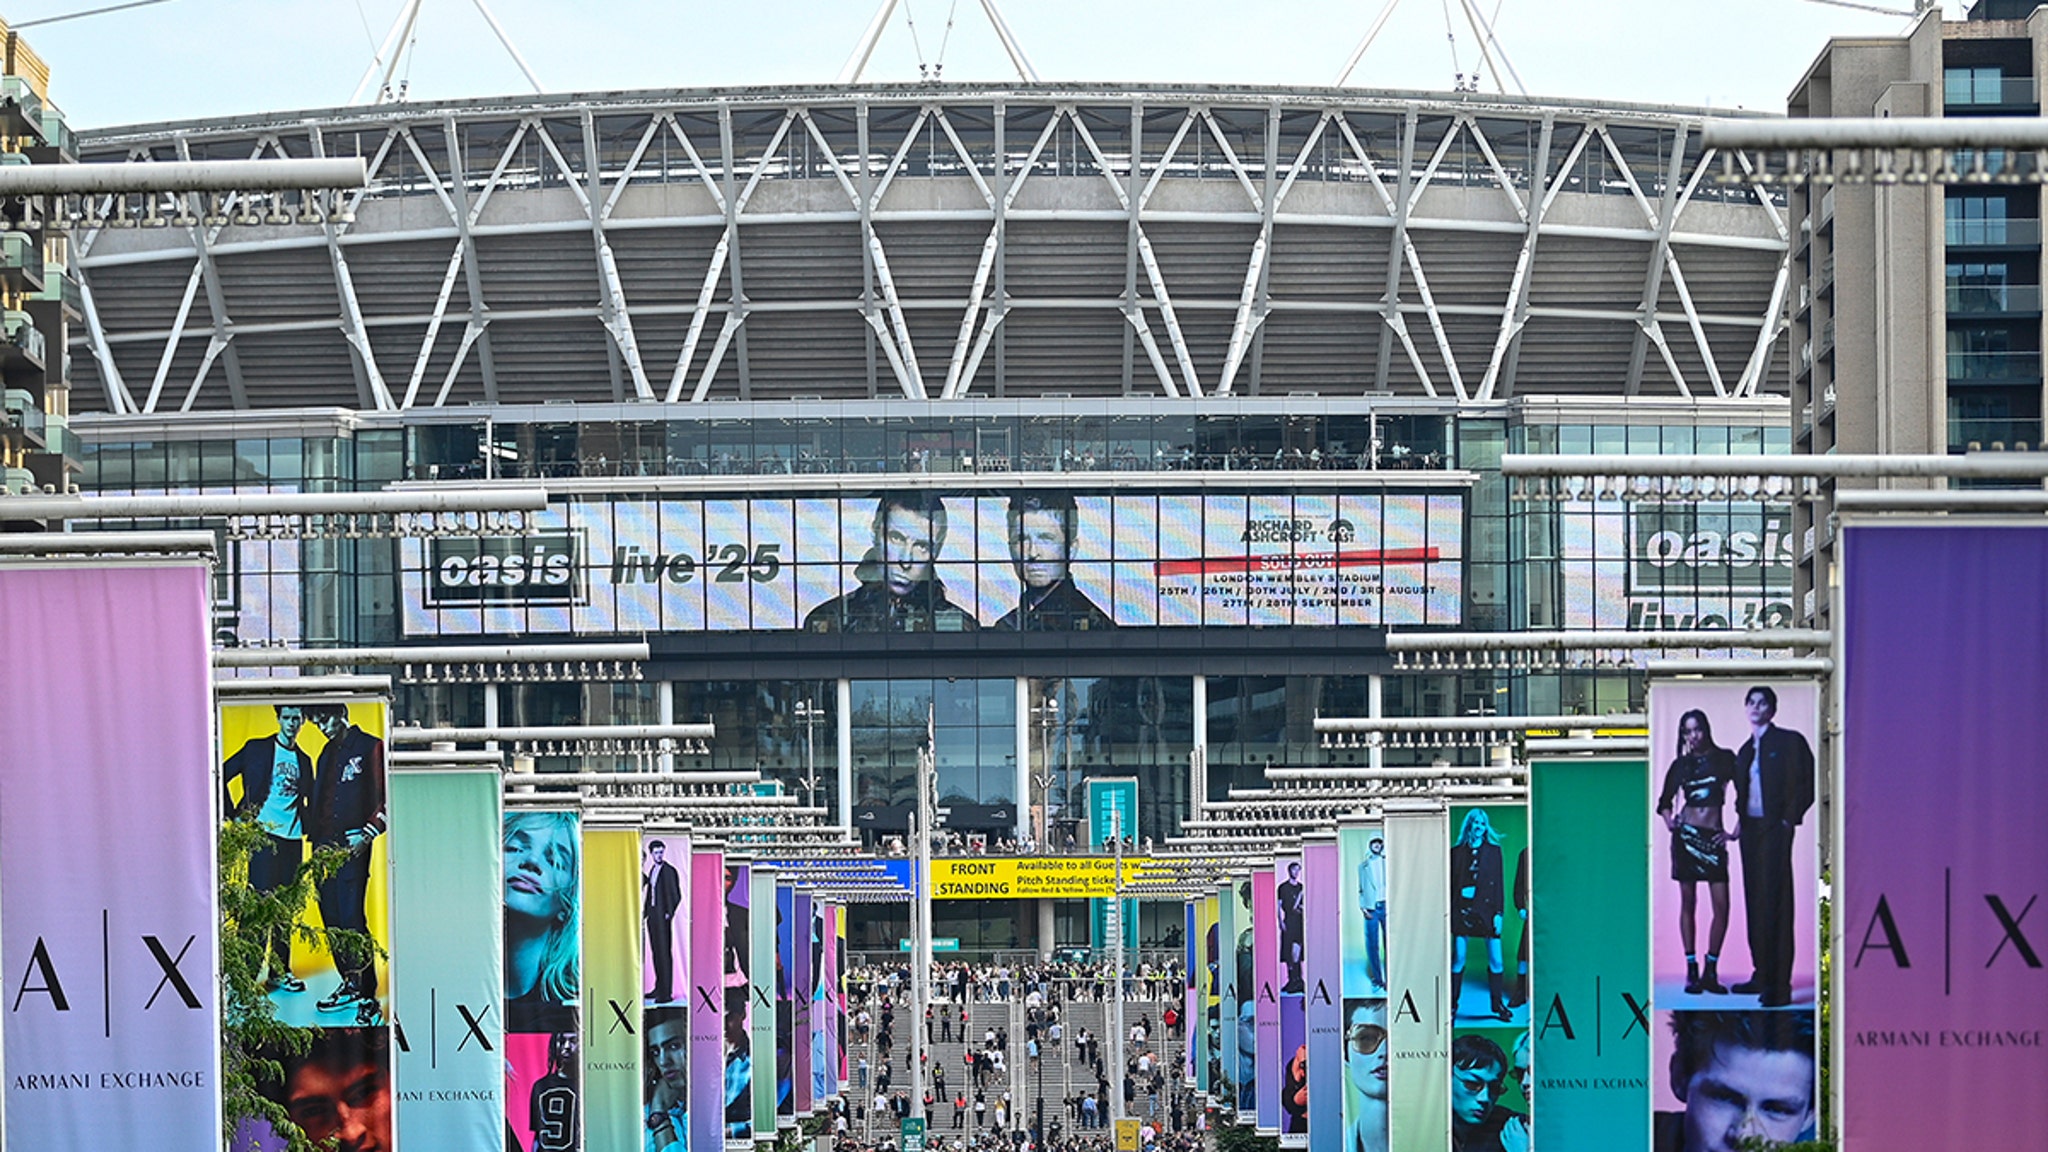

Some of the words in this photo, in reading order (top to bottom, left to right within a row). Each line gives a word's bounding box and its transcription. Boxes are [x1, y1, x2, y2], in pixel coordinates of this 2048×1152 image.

[1246, 519, 1312, 532] RICHARD
[1241, 530, 1318, 542] ASHCROFT
[440, 545, 570, 587] oasis
[610, 545, 695, 584] live
[707, 543, 781, 583] '25
[1261, 554, 1302, 571] SOLD
[1304, 552, 1334, 569] OUT
[1213, 575, 1263, 583] LONDON
[1267, 574, 1324, 583] WEMBLEY
[1327, 574, 1380, 583] STADIUM
[1160, 587, 1189, 595] 25TH
[1203, 587, 1233, 595] 26TH
[1281, 586, 1310, 595] JULY
[1389, 586, 1437, 595] AUGUST
[1301, 599, 1372, 608] SEPTEMBER
[951, 863, 996, 875] FRONT
[1017, 861, 1064, 871] Available
[1066, 862, 1078, 871] to
[1080, 861, 1092, 870] all
[1094, 861, 1128, 870] Guets
[1017, 875, 1043, 885] Pitch
[1045, 875, 1089, 887] Standing
[1092, 875, 1124, 885] tickes
[939, 881, 1010, 895] STANDING
[753, 985, 771, 1008] X
[1258, 981, 1276, 1004] A
[1310, 978, 1332, 1006] A
[696, 985, 719, 1013] X
[1855, 1030, 1930, 1047] ARMANI
[1940, 1030, 2043, 1047] EXCHANGE
[1395, 1051, 1430, 1060] ARMANI
[588, 1062, 637, 1071] EXCHANGE
[14, 1072, 91, 1090] ARMANI
[101, 1070, 206, 1089] EXCHANGE
[1540, 1079, 1588, 1090] ARMANI
[429, 1089, 495, 1101] EXCHANGE
[539, 1087, 576, 1150] 9
